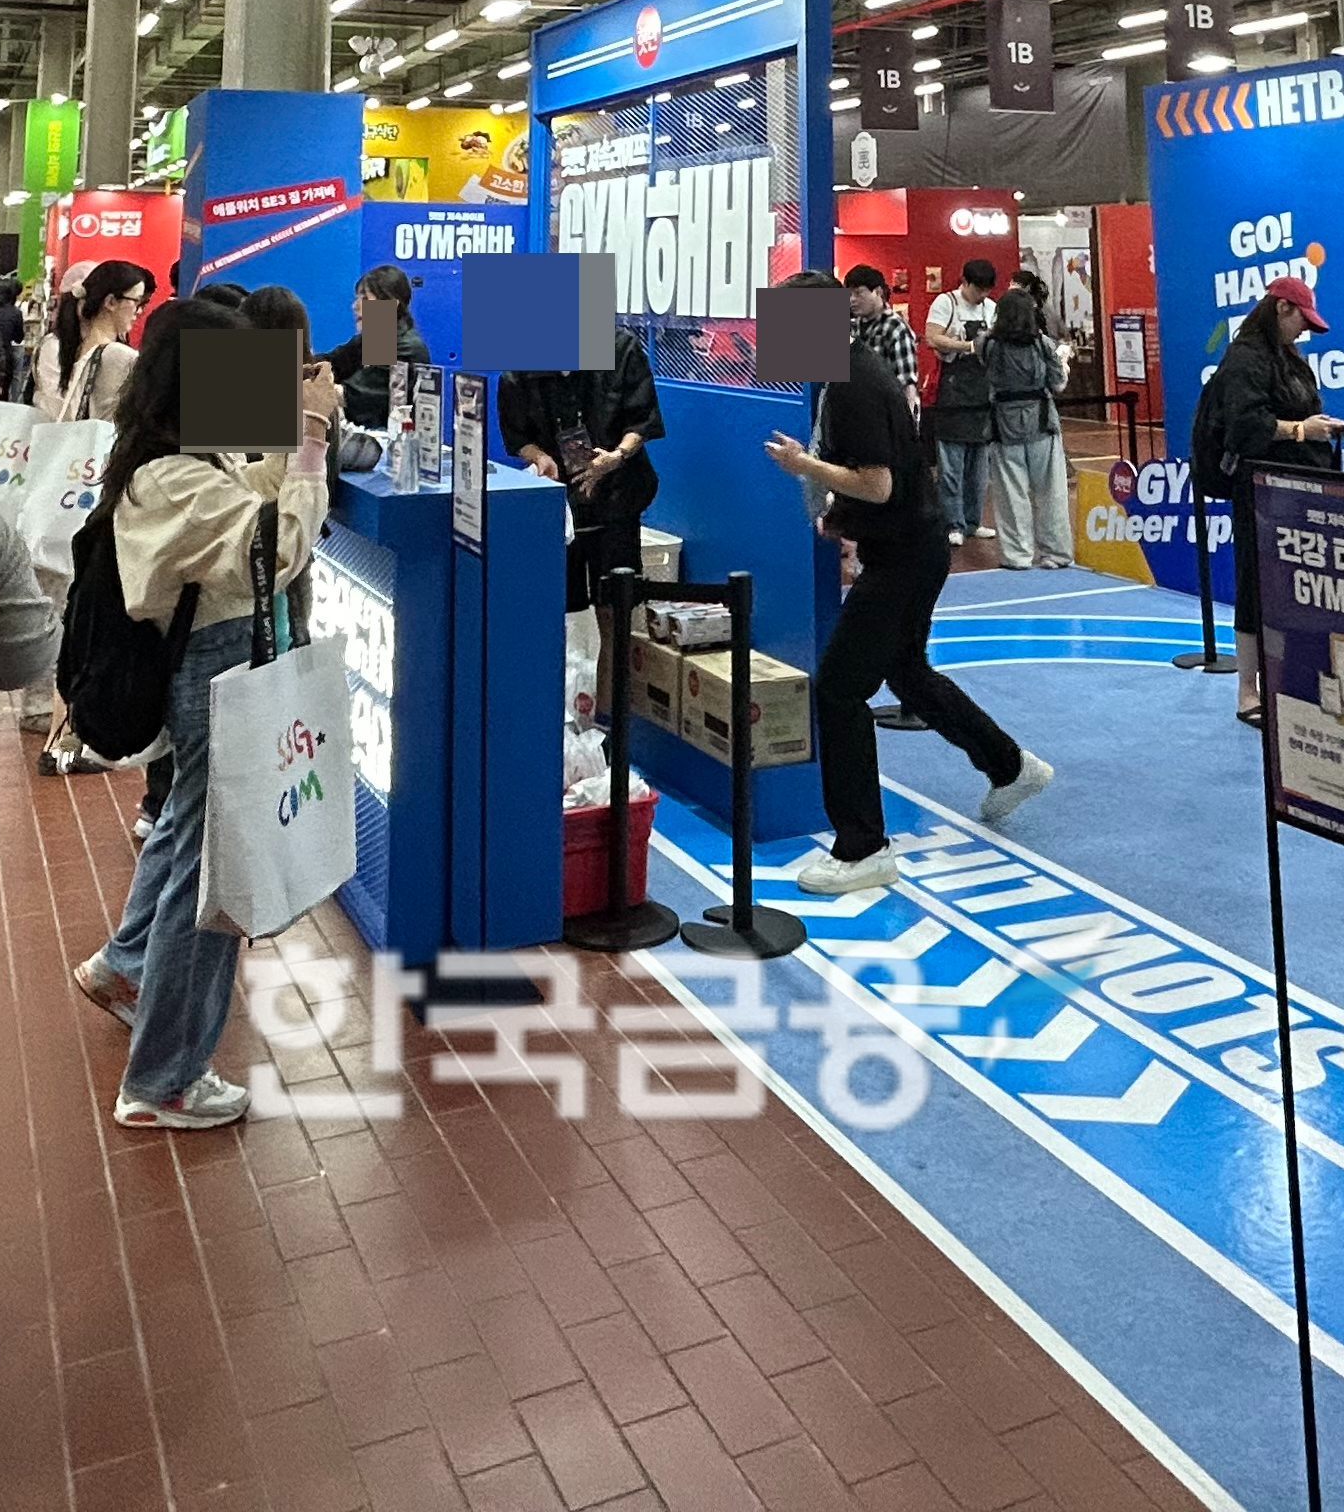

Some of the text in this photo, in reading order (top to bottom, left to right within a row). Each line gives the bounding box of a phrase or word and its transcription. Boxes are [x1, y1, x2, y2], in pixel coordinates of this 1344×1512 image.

[1185, 3, 1214, 30] 1B
[1007, 41, 1034, 64] 1B
[876, 69, 901, 89] 1B
[100, 222, 142, 237] 농심
[1230, 211, 1293, 258] GO!
[1086, 505, 1179, 543] Cheer
[1276, 526, 1328, 569] 건강
